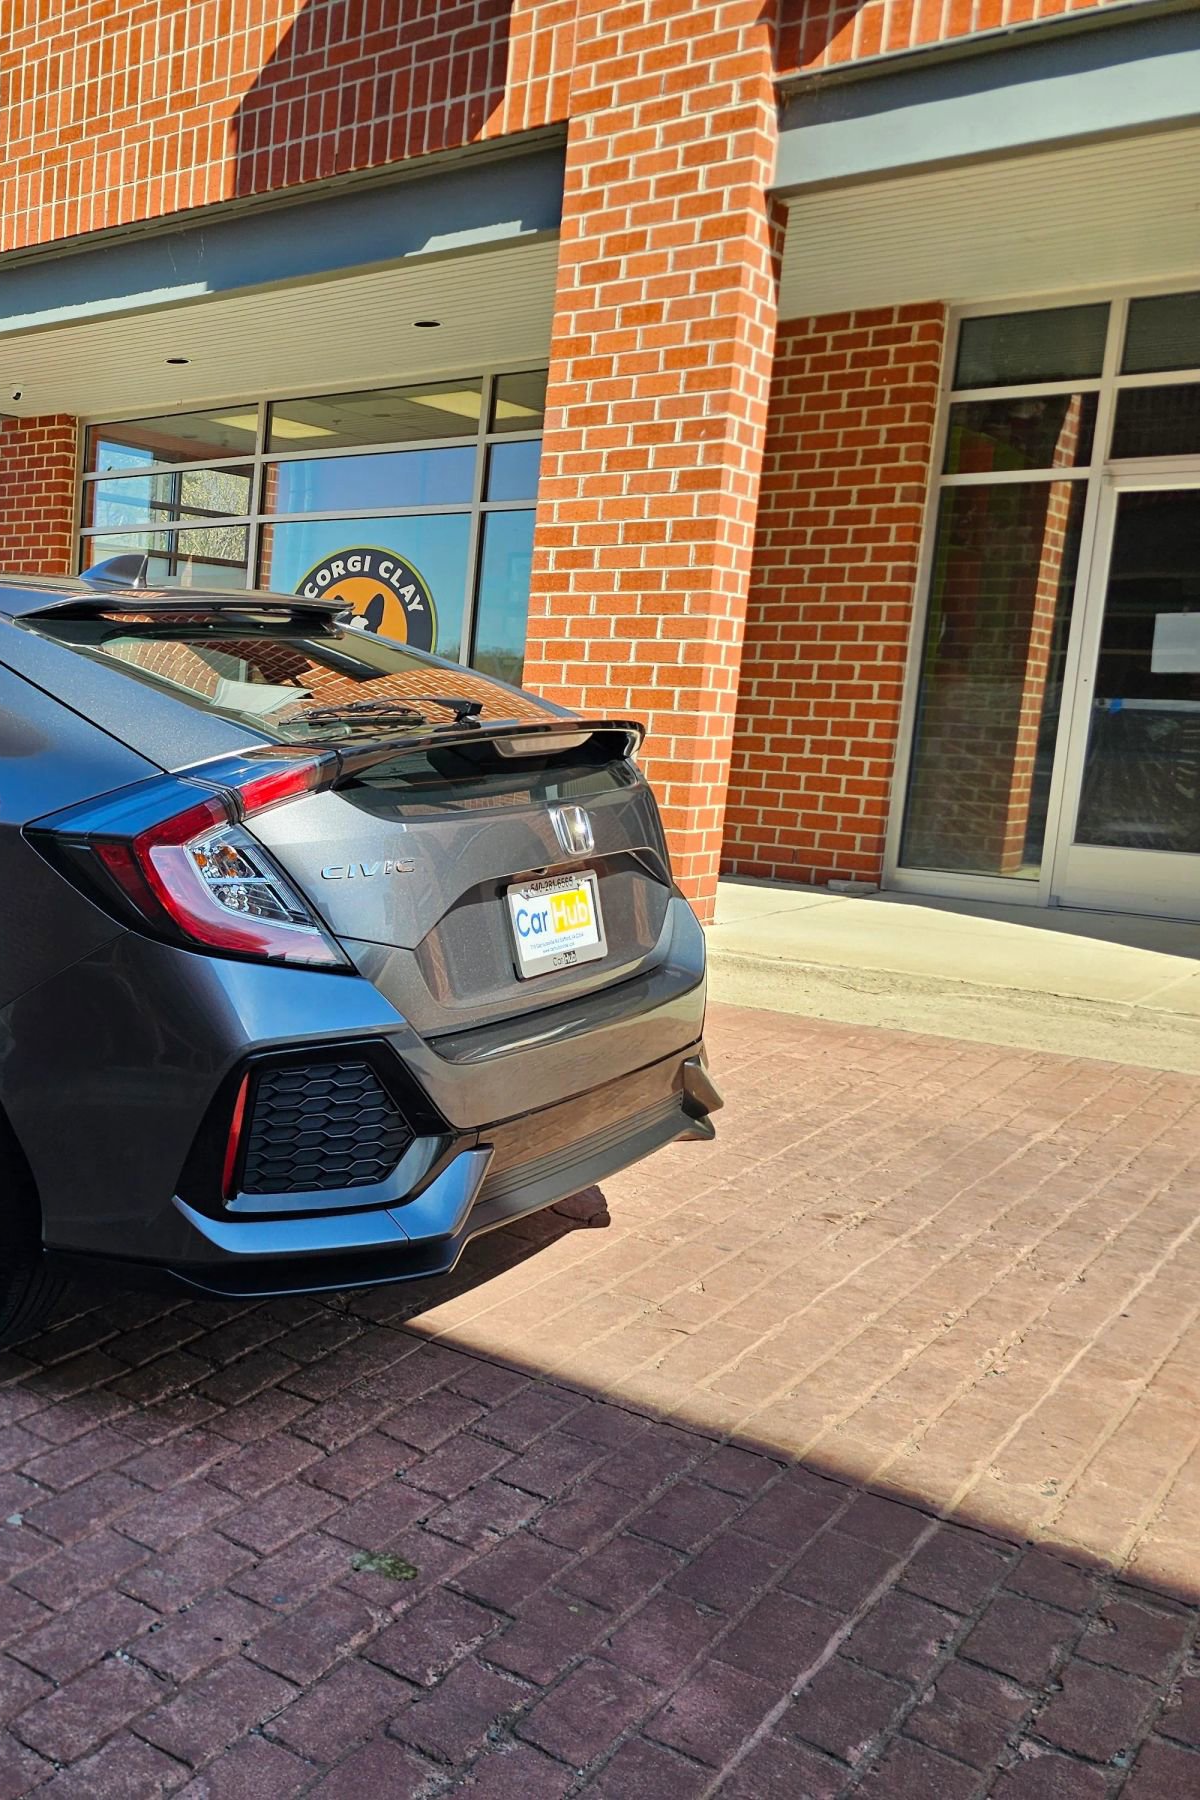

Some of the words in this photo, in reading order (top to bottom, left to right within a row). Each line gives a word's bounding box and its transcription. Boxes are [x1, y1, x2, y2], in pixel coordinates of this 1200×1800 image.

[303, 555, 372, 599] CORGI
[378, 560, 424, 612] CLAY
[321, 858, 415, 880] CIVIC
